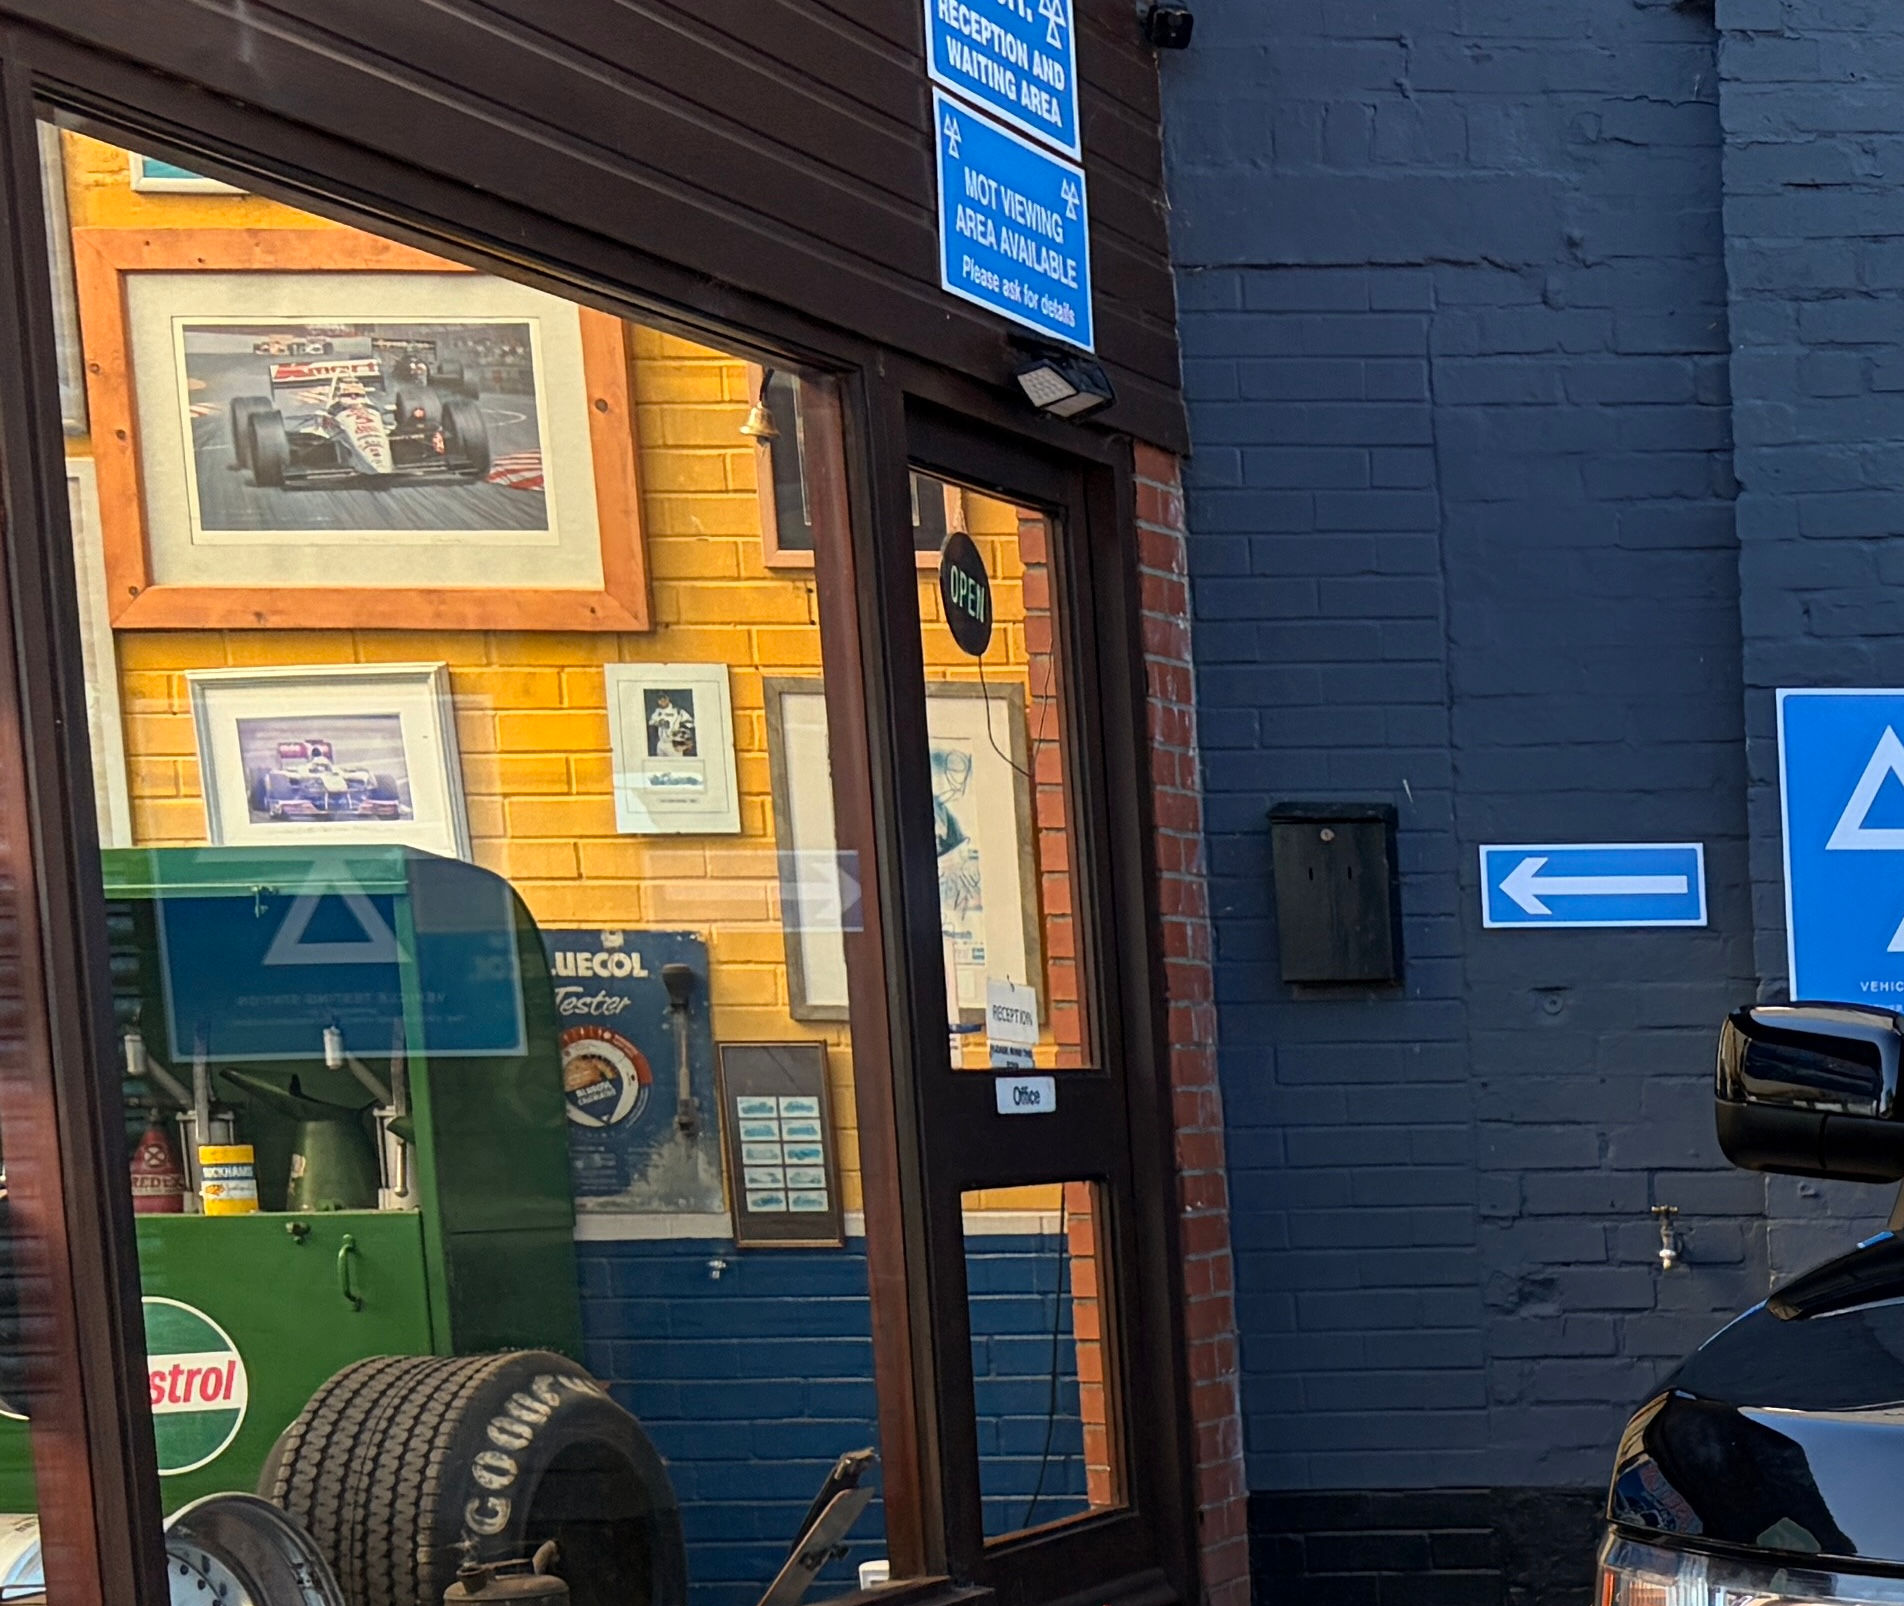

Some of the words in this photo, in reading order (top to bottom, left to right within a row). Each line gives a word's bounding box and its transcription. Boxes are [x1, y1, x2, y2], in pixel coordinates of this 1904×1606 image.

[938, 0, 1029, 71] RECEPTION
[1032, 49, 1065, 91] AND
[945, 34, 1017, 101] WAITING
[1021, 79, 1062, 128] AREA
[964, 166, 998, 210] MOT
[1001, 185, 1064, 244] VIEWING
[956, 203, 998, 250] AREA
[1001, 226, 1078, 289] AVAILABLE
[962, 254, 1000, 293] Please
[1002, 278, 1022, 303] ask
[1024, 283, 1038, 309] for
[1041, 293, 1076, 327] details
[950, 564, 986, 624] OPEN
[551, 951, 648, 977] UECOL
[554, 986, 632, 1015] Tester
[992, 1004, 1033, 1027] RECEPTION
[1013, 1086, 1041, 1106] Office
[150, 1360, 236, 1405] strol
